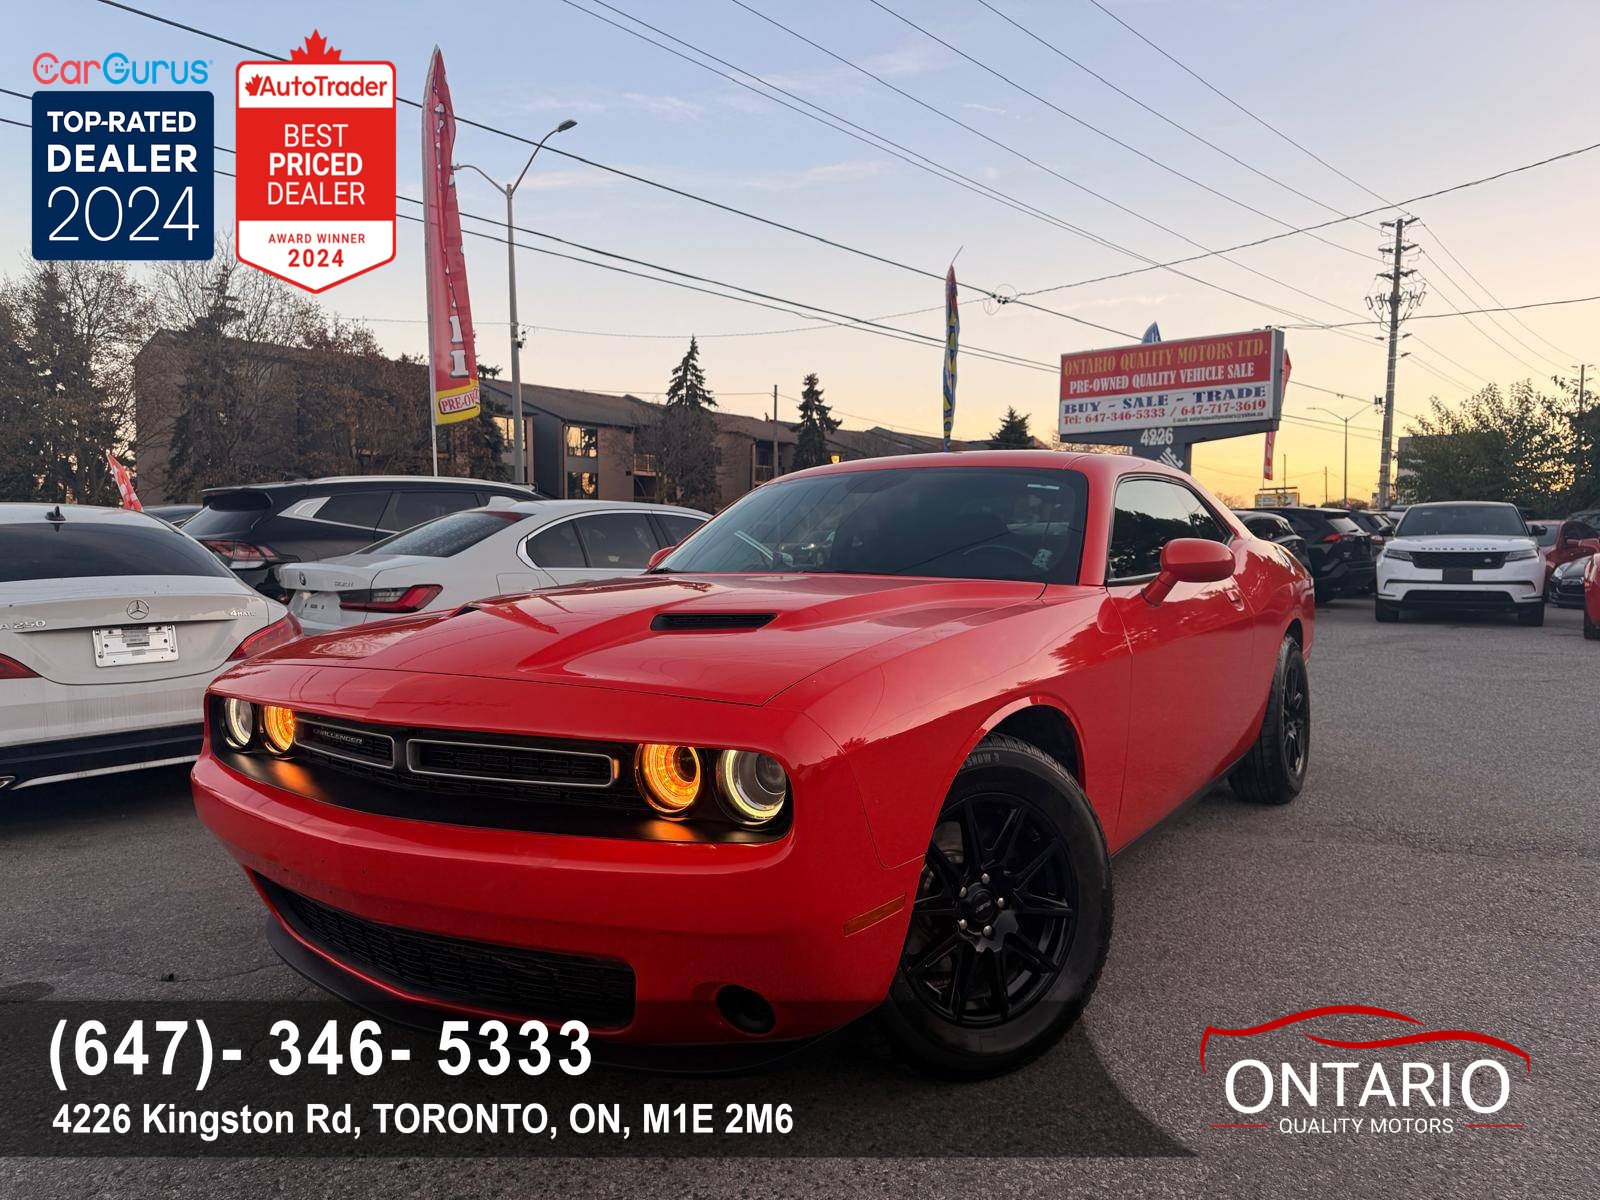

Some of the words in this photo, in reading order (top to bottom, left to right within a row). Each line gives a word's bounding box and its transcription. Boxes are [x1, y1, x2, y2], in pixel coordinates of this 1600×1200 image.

[1064, 355, 1116, 376] ONTARIO
[1120, 349, 1174, 371] QUALITY
[1177, 342, 1233, 364] MOTORS
[1237, 338, 1268, 357] LTD.
[1069, 375, 1129, 394] PRE-OWNED
[1132, 370, 1177, 389] QUALITY
[1179, 365, 1224, 384] VEHICLE
[1227, 362, 1255, 379] SALE
[1064, 401, 1101, 414] BUY
[1122, 394, 1168, 410] SALE
[1193, 386, 1266, 404] TRADE
[1085, 408, 1166, 423] 647-346-5333
[1140, 427, 1174, 447] 4226
